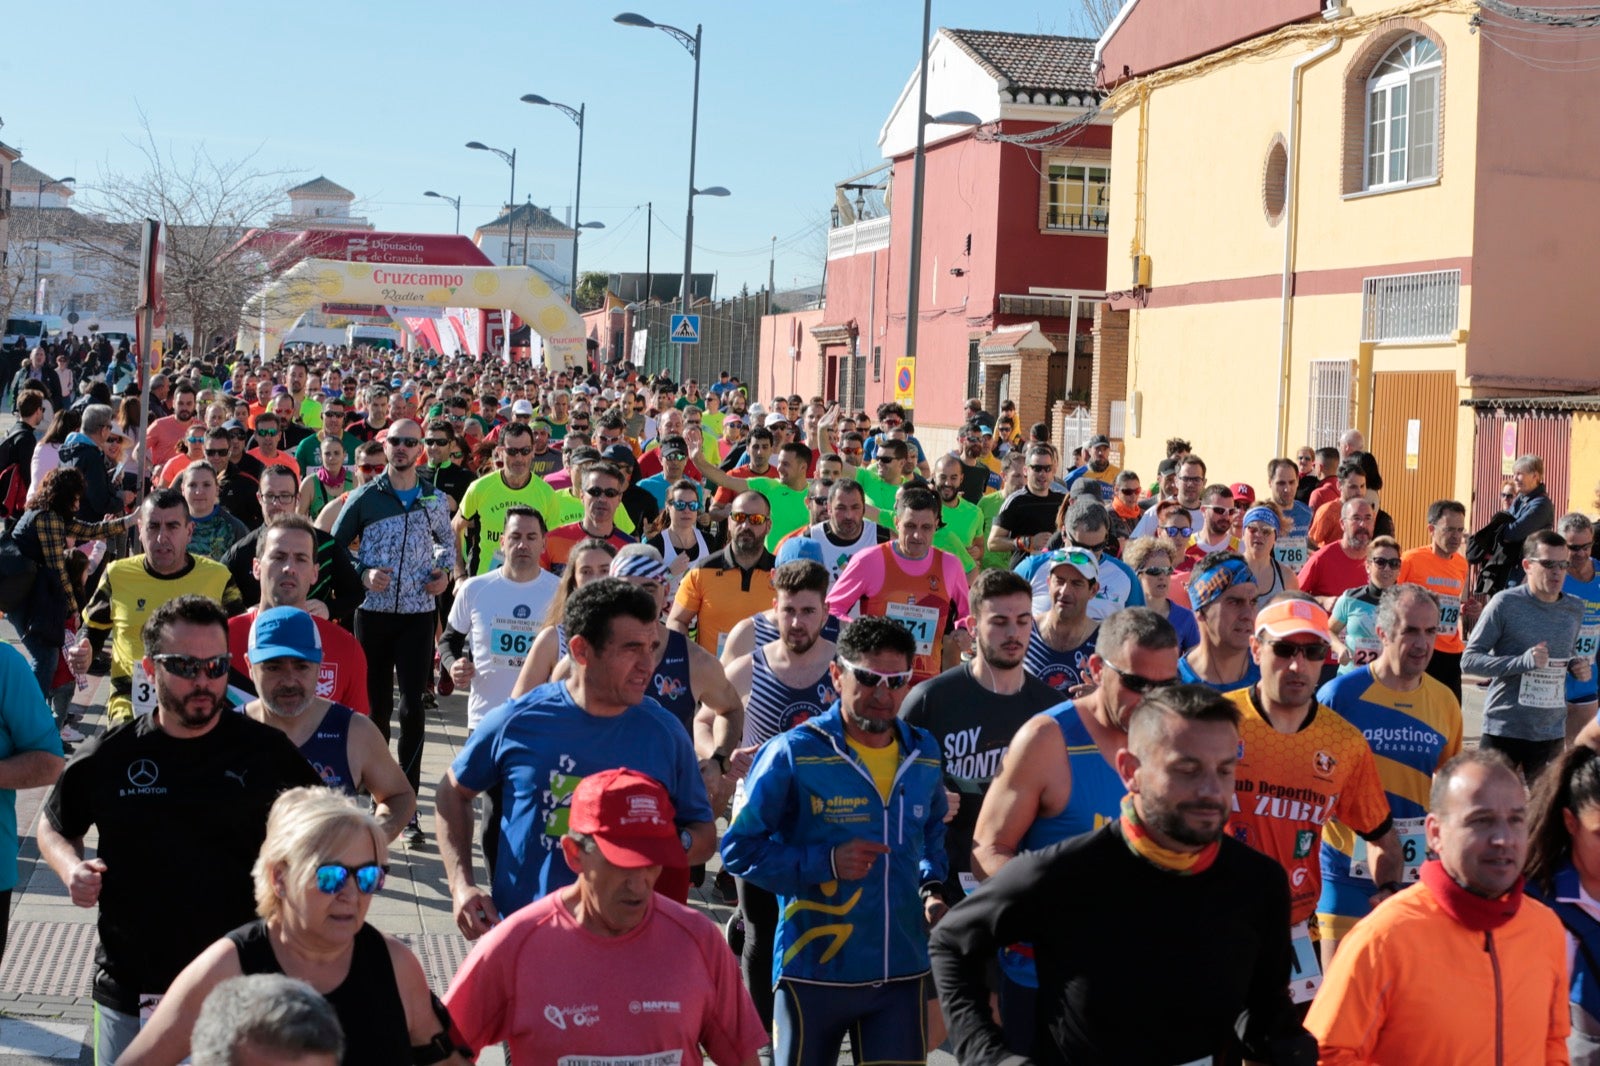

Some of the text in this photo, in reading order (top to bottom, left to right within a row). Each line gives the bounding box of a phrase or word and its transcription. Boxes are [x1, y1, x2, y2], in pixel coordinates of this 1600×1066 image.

[371, 239, 424, 252] Diputación
[371, 253, 424, 263] de Granada
[373, 269, 464, 288] Cruzcampo
[381, 289, 424, 302] Radler
[487, 530, 502, 542] RU
[1279, 549, 1302, 562] 786
[1440, 607, 1459, 623] 128
[1363, 726, 1439, 745] agustinos
[944, 726, 982, 759] SOY
[1376, 744, 1430, 753] GRANADA
[1259, 781, 1326, 805] Deportivo
[642, 1001, 680, 1009] MAPFRE
